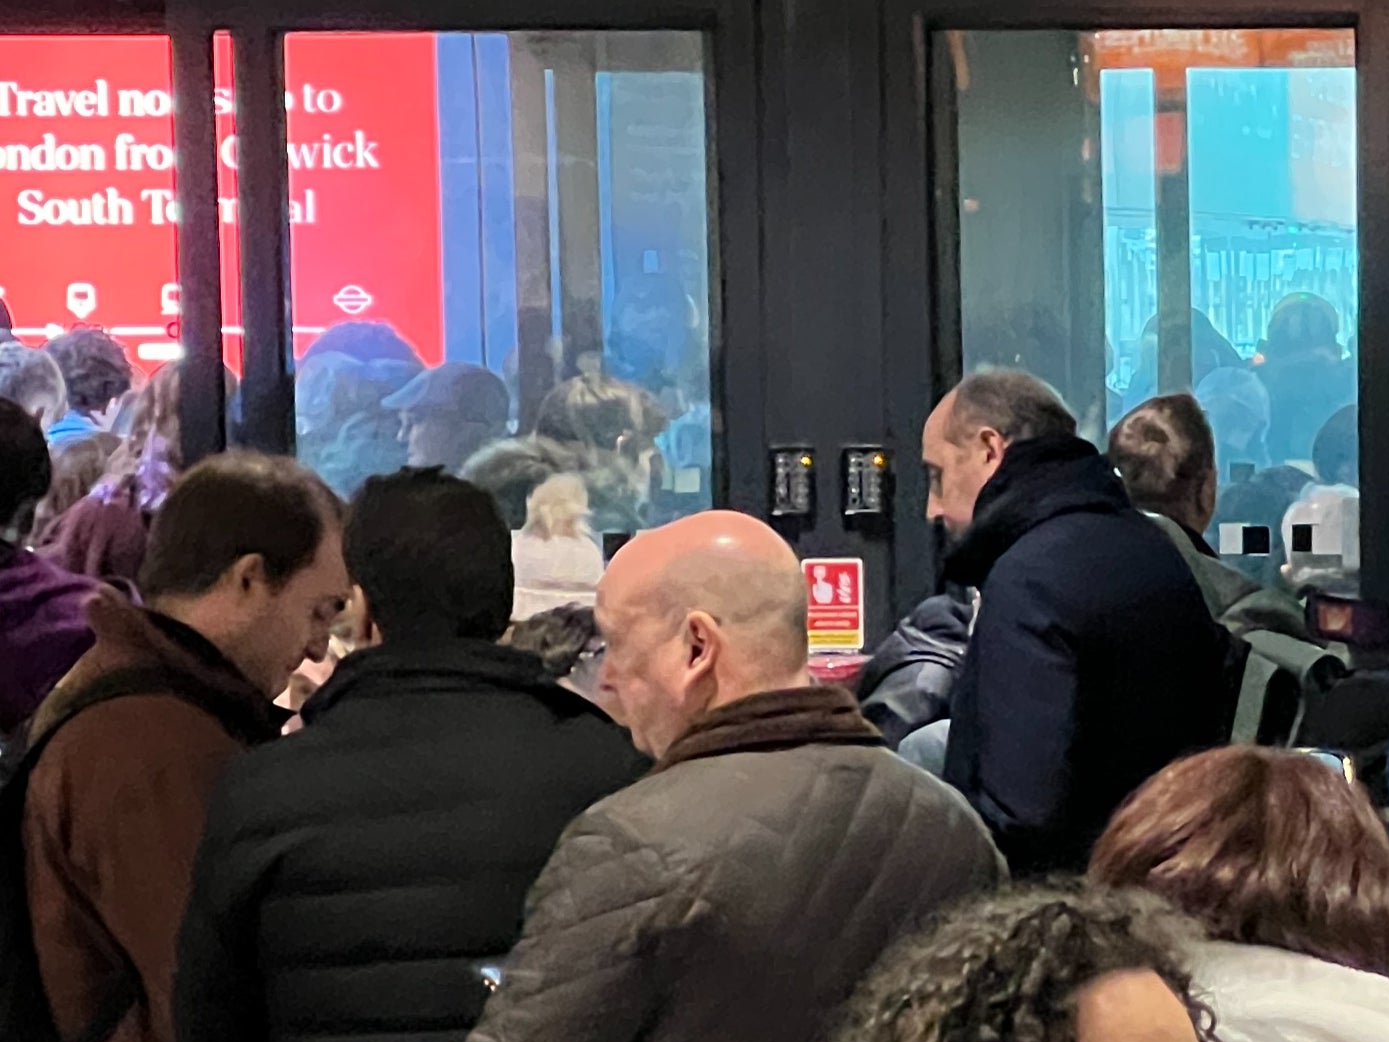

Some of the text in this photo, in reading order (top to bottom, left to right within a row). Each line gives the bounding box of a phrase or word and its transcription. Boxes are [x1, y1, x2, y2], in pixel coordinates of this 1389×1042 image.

[0, 79, 108, 117] Travel
[303, 83, 343, 113] to
[115, 133, 175, 171] fro
[17, 186, 134, 225] South
